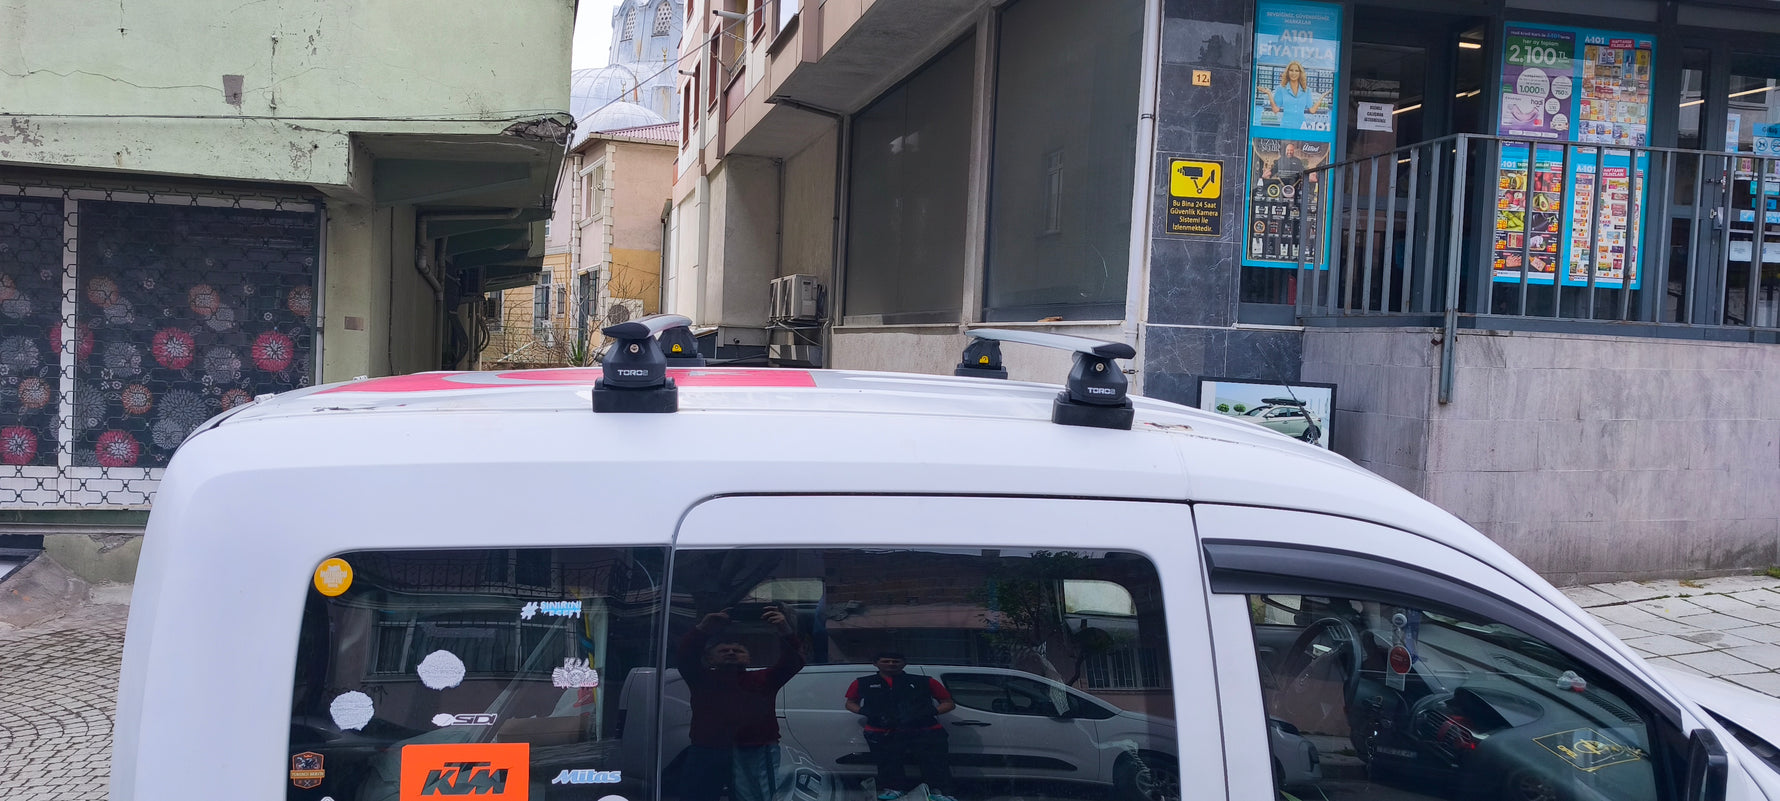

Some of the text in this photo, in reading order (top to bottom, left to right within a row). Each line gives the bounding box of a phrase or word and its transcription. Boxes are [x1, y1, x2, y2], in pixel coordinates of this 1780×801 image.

[1258, 41, 1334, 60] FİYATIYLA
[1509, 44, 1557, 66] 2.100
[1519, 85, 1541, 94] 1.000
[1172, 199, 1181, 207] Bu
[1181, 200, 1195, 208] Bina
[1170, 207, 1219, 217] Güvenlik Kamera
[1179, 215, 1201, 224] Sistemi
[420, 761, 509, 796] KTM
[551, 769, 622, 784] Mitas
